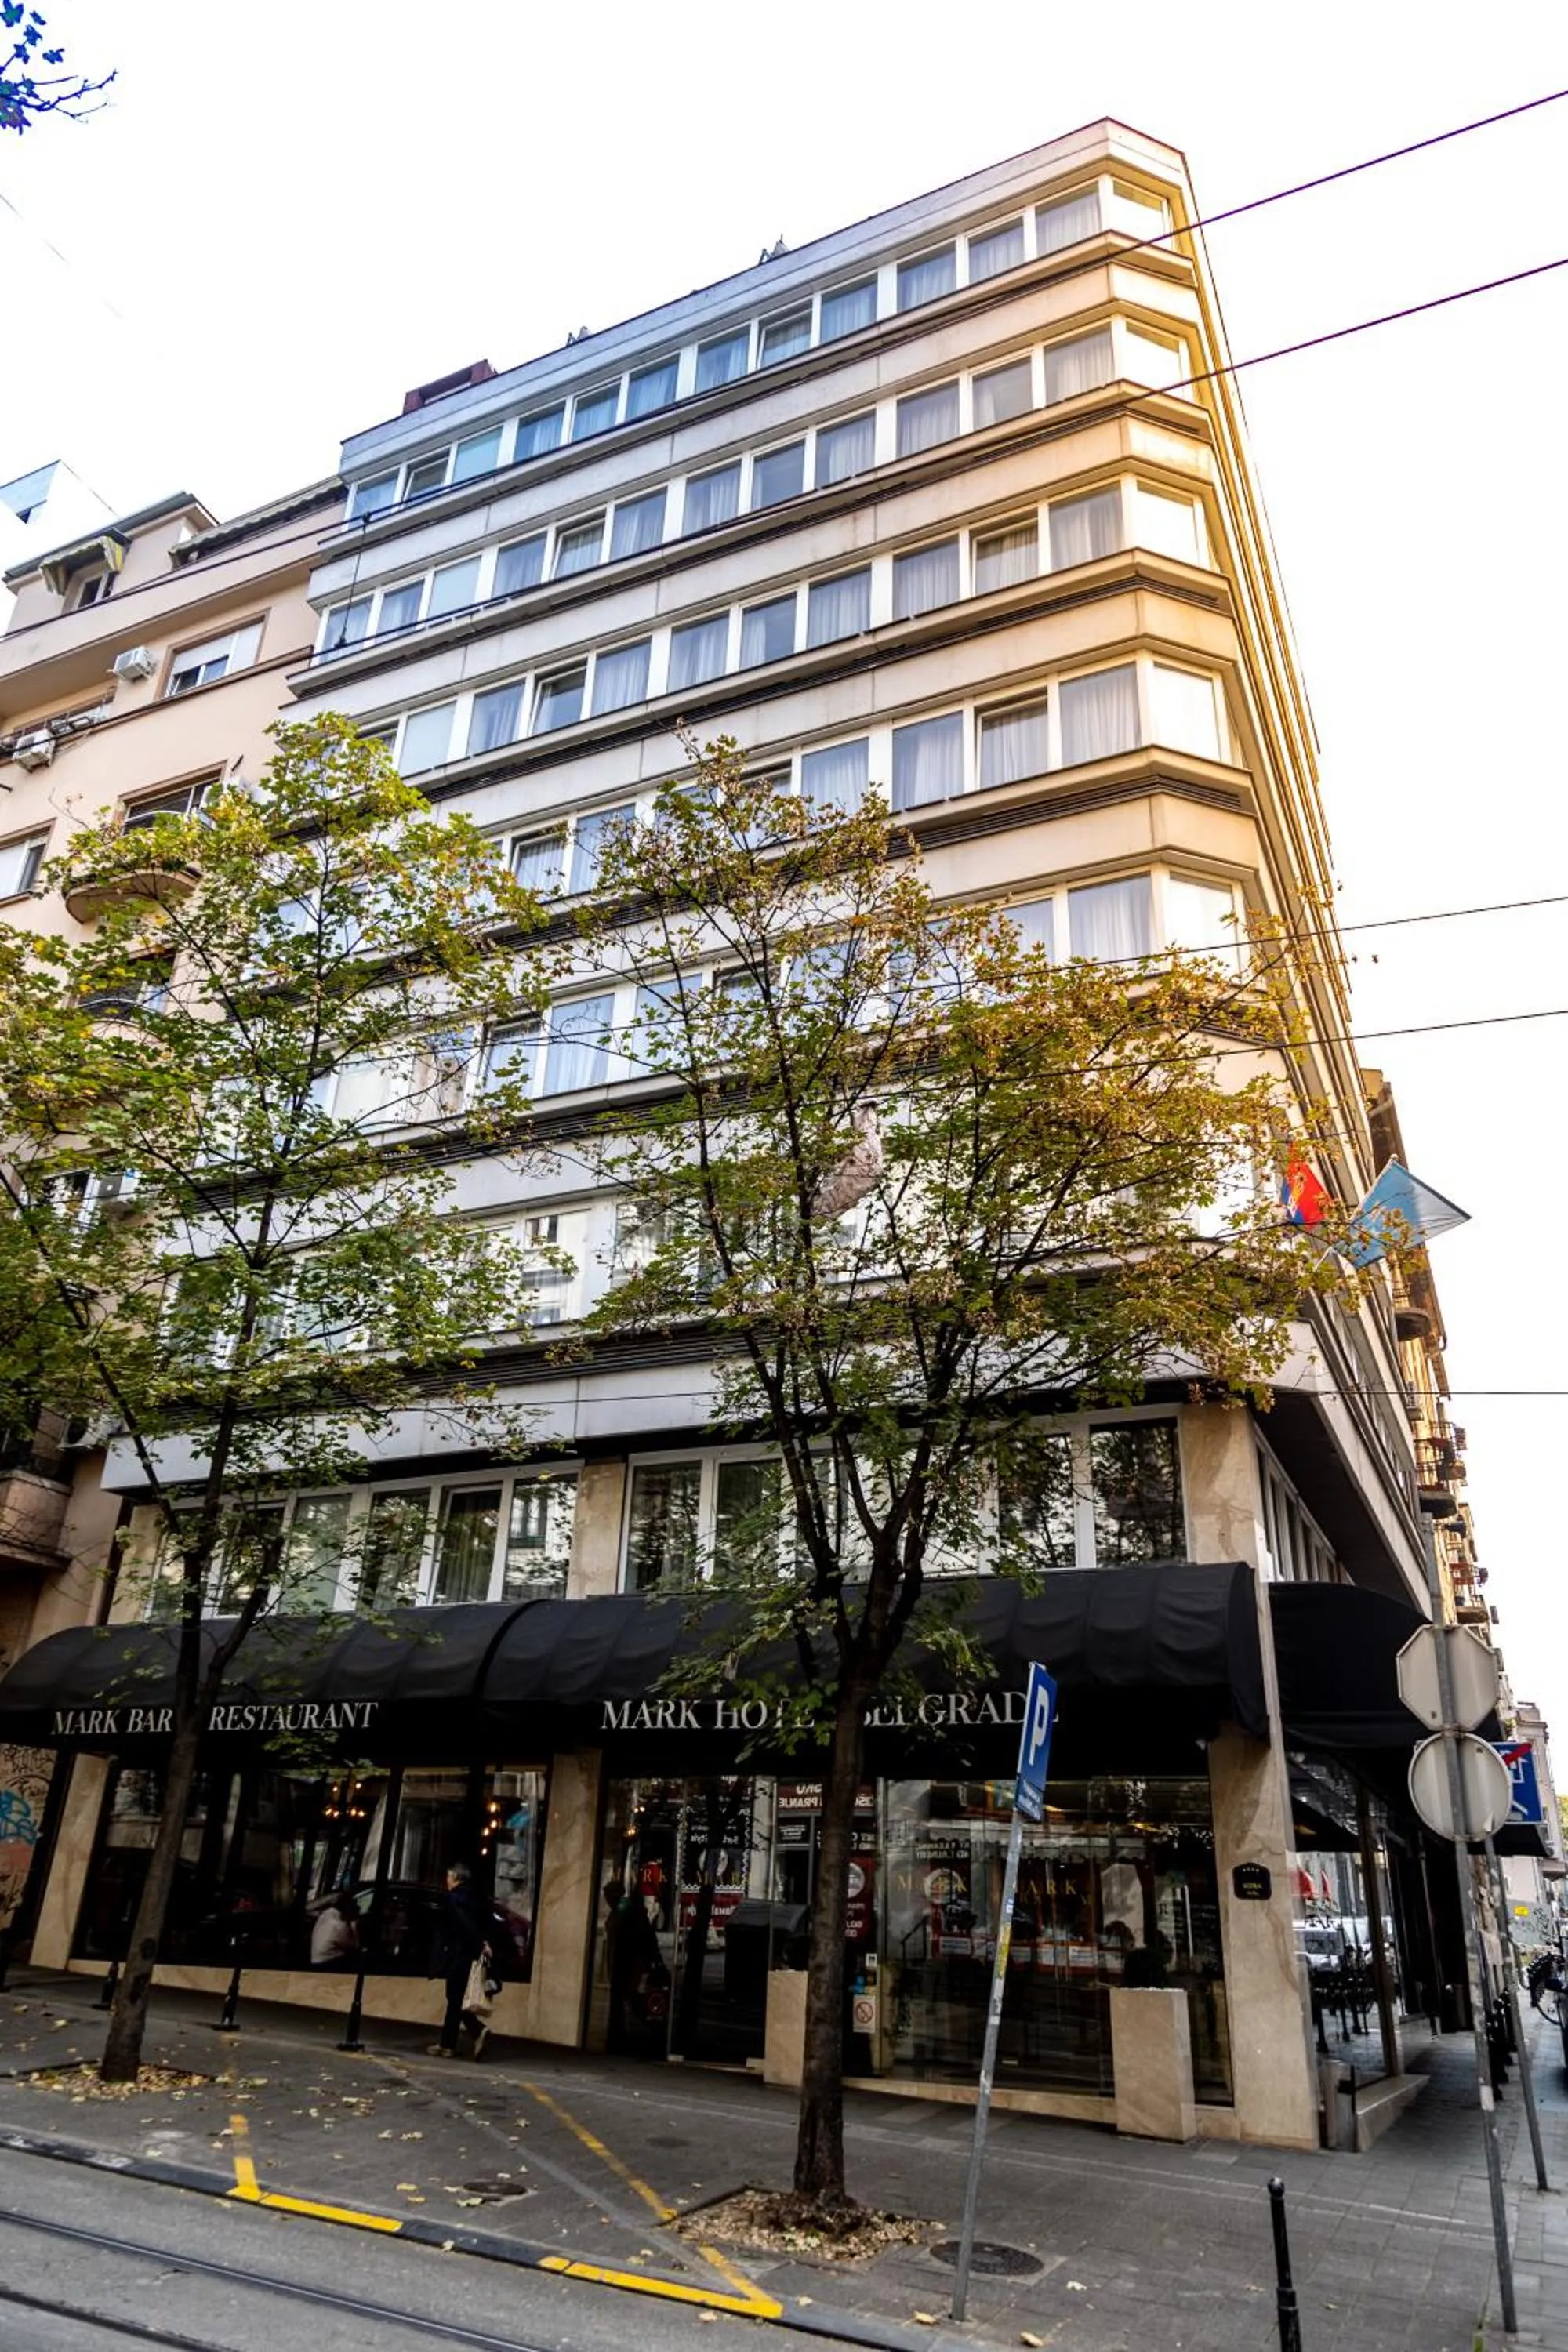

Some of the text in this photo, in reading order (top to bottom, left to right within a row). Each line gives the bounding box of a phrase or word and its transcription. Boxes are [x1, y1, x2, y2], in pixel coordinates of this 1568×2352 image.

[49, 1701, 379, 1735] MARK BAR RESTAURANT
[599, 1690, 1060, 1730] MARK HOTE ELGRAD
[1028, 1683, 1050, 1767] P
